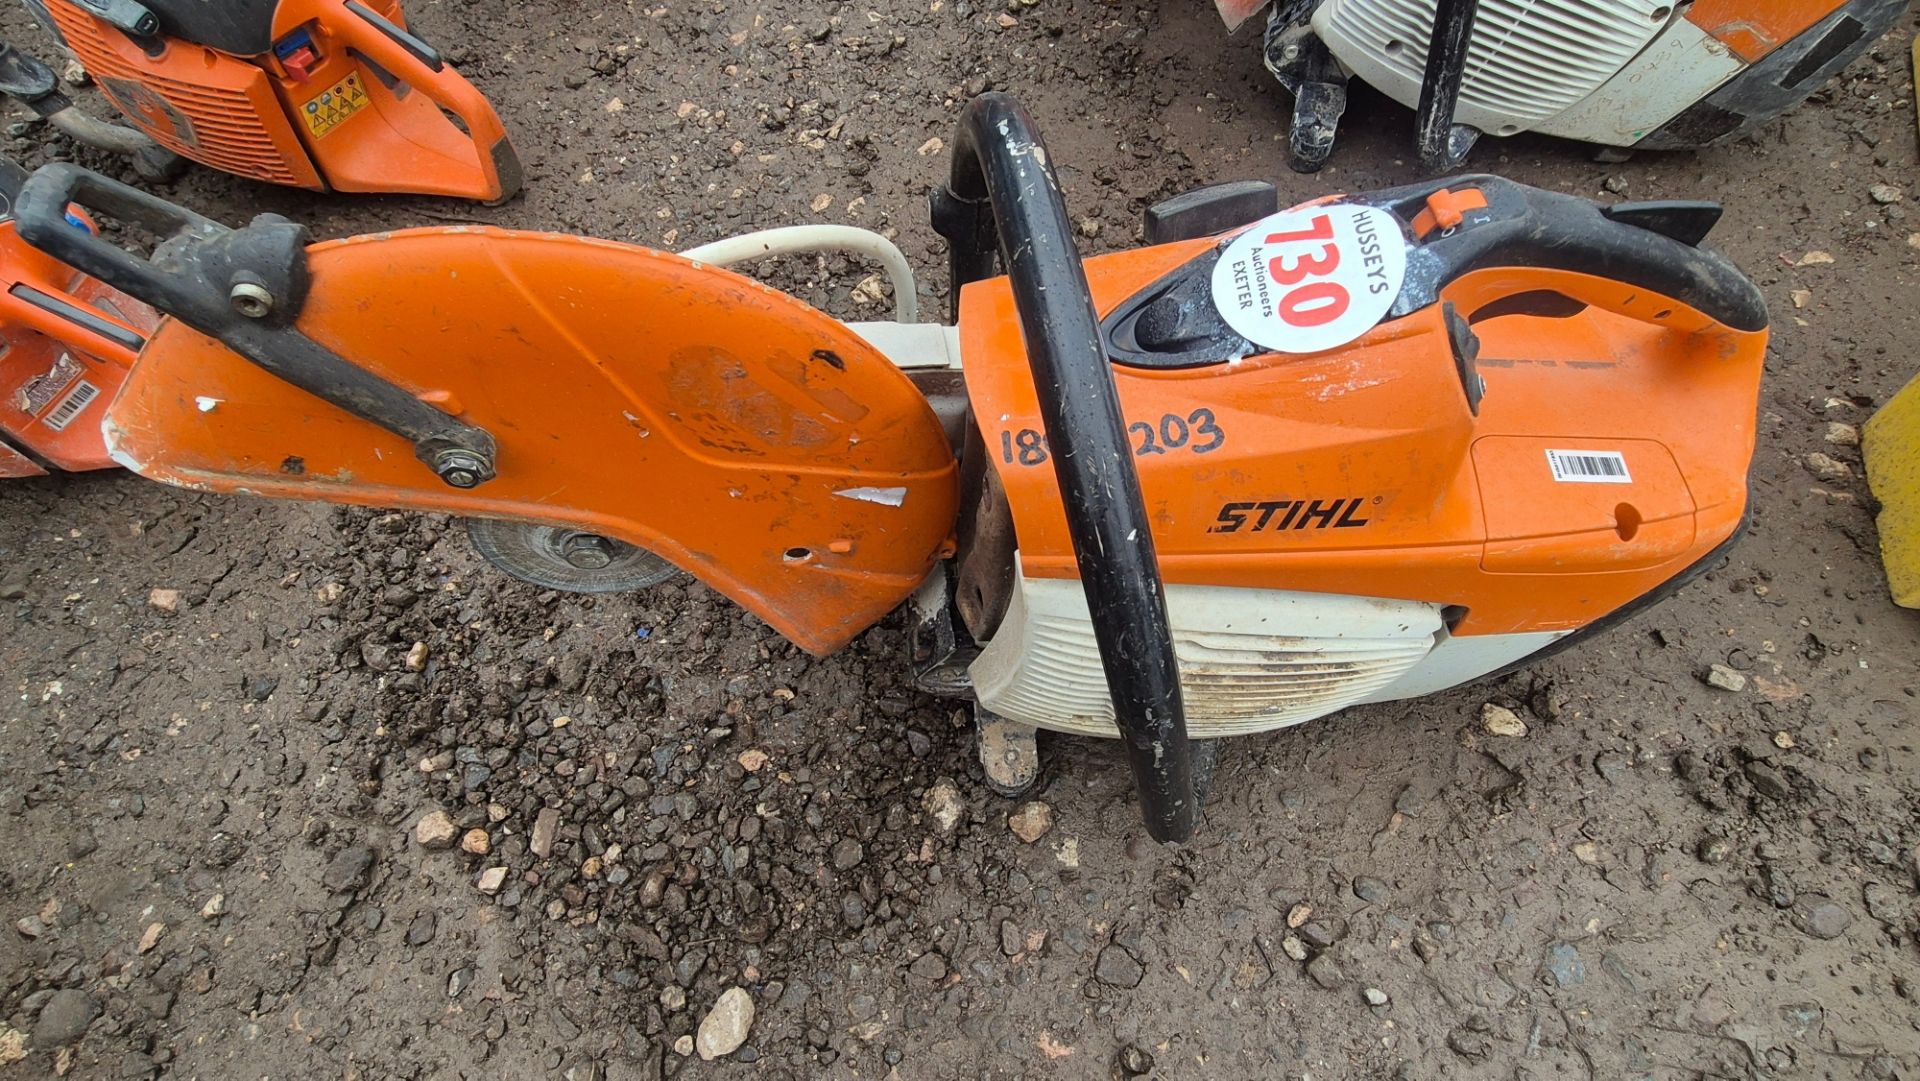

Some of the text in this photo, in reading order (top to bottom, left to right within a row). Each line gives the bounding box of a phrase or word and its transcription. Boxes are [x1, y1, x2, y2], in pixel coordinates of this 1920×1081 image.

[1232, 260, 1253, 309] EXETER
[1251, 247, 1273, 318] Auctioneers
[1264, 214, 1350, 327] 730
[1352, 209, 1389, 294] HUSSEYS
[1207, 498, 1369, 533] STIHL
